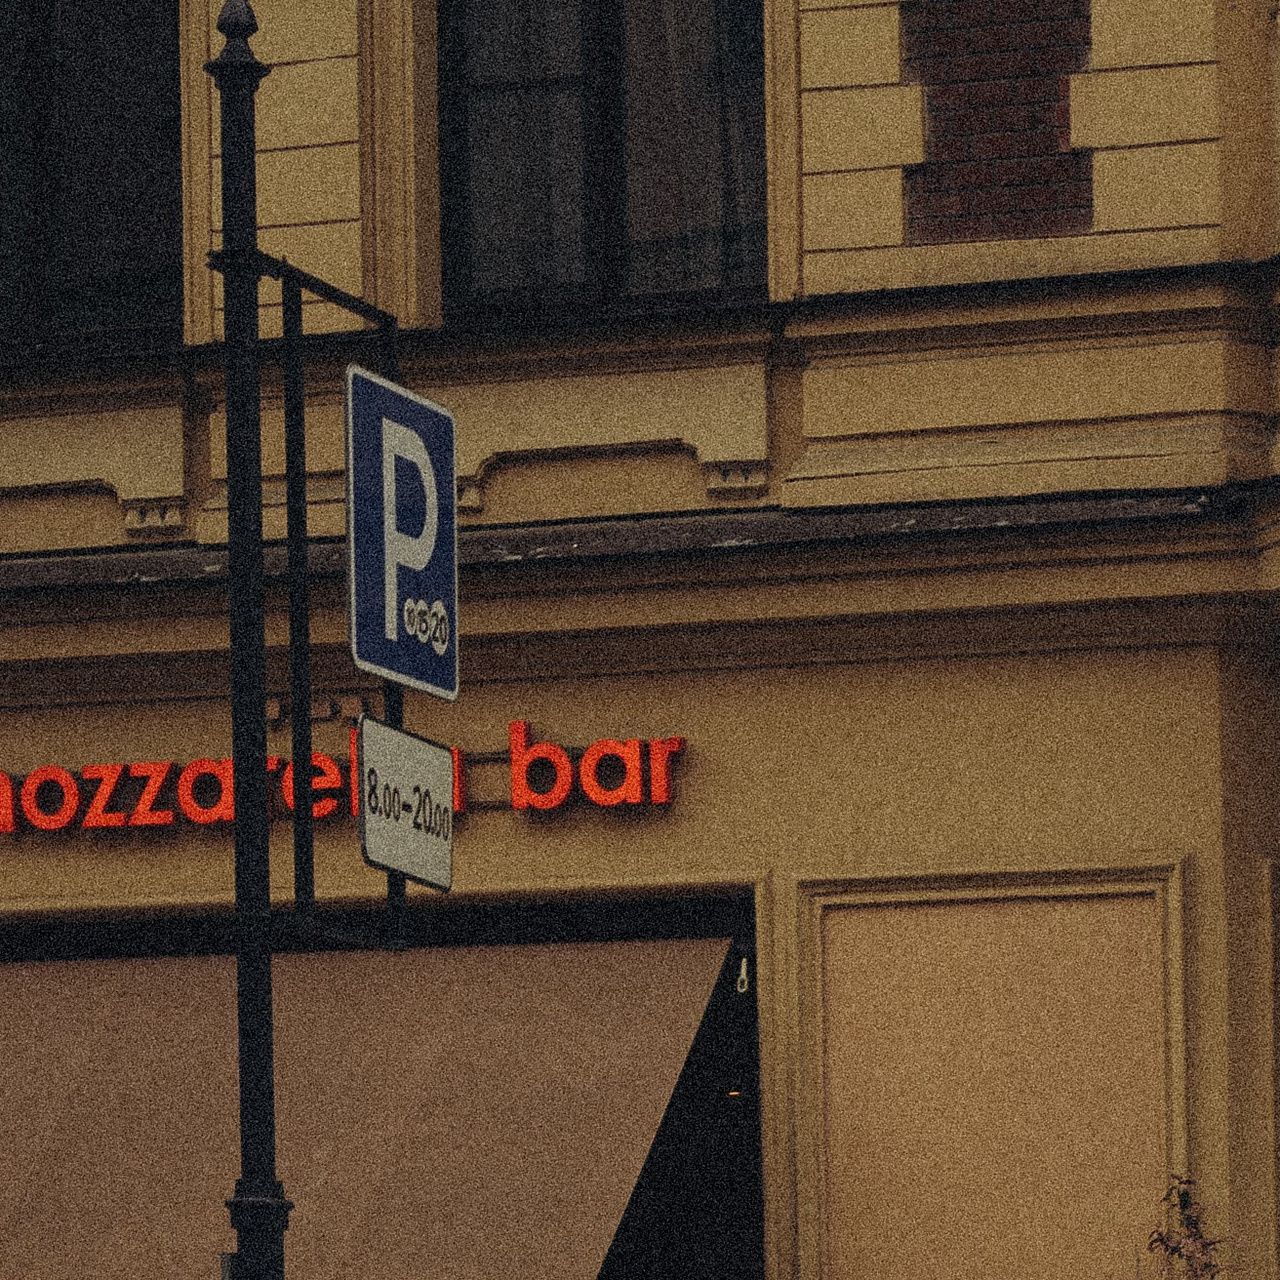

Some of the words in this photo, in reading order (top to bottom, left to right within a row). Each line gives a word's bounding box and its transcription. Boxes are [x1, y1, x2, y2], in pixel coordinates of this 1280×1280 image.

[382, 417, 438, 642] P
[431, 611, 448, 646] 20
[509, 720, 686, 810] bar
